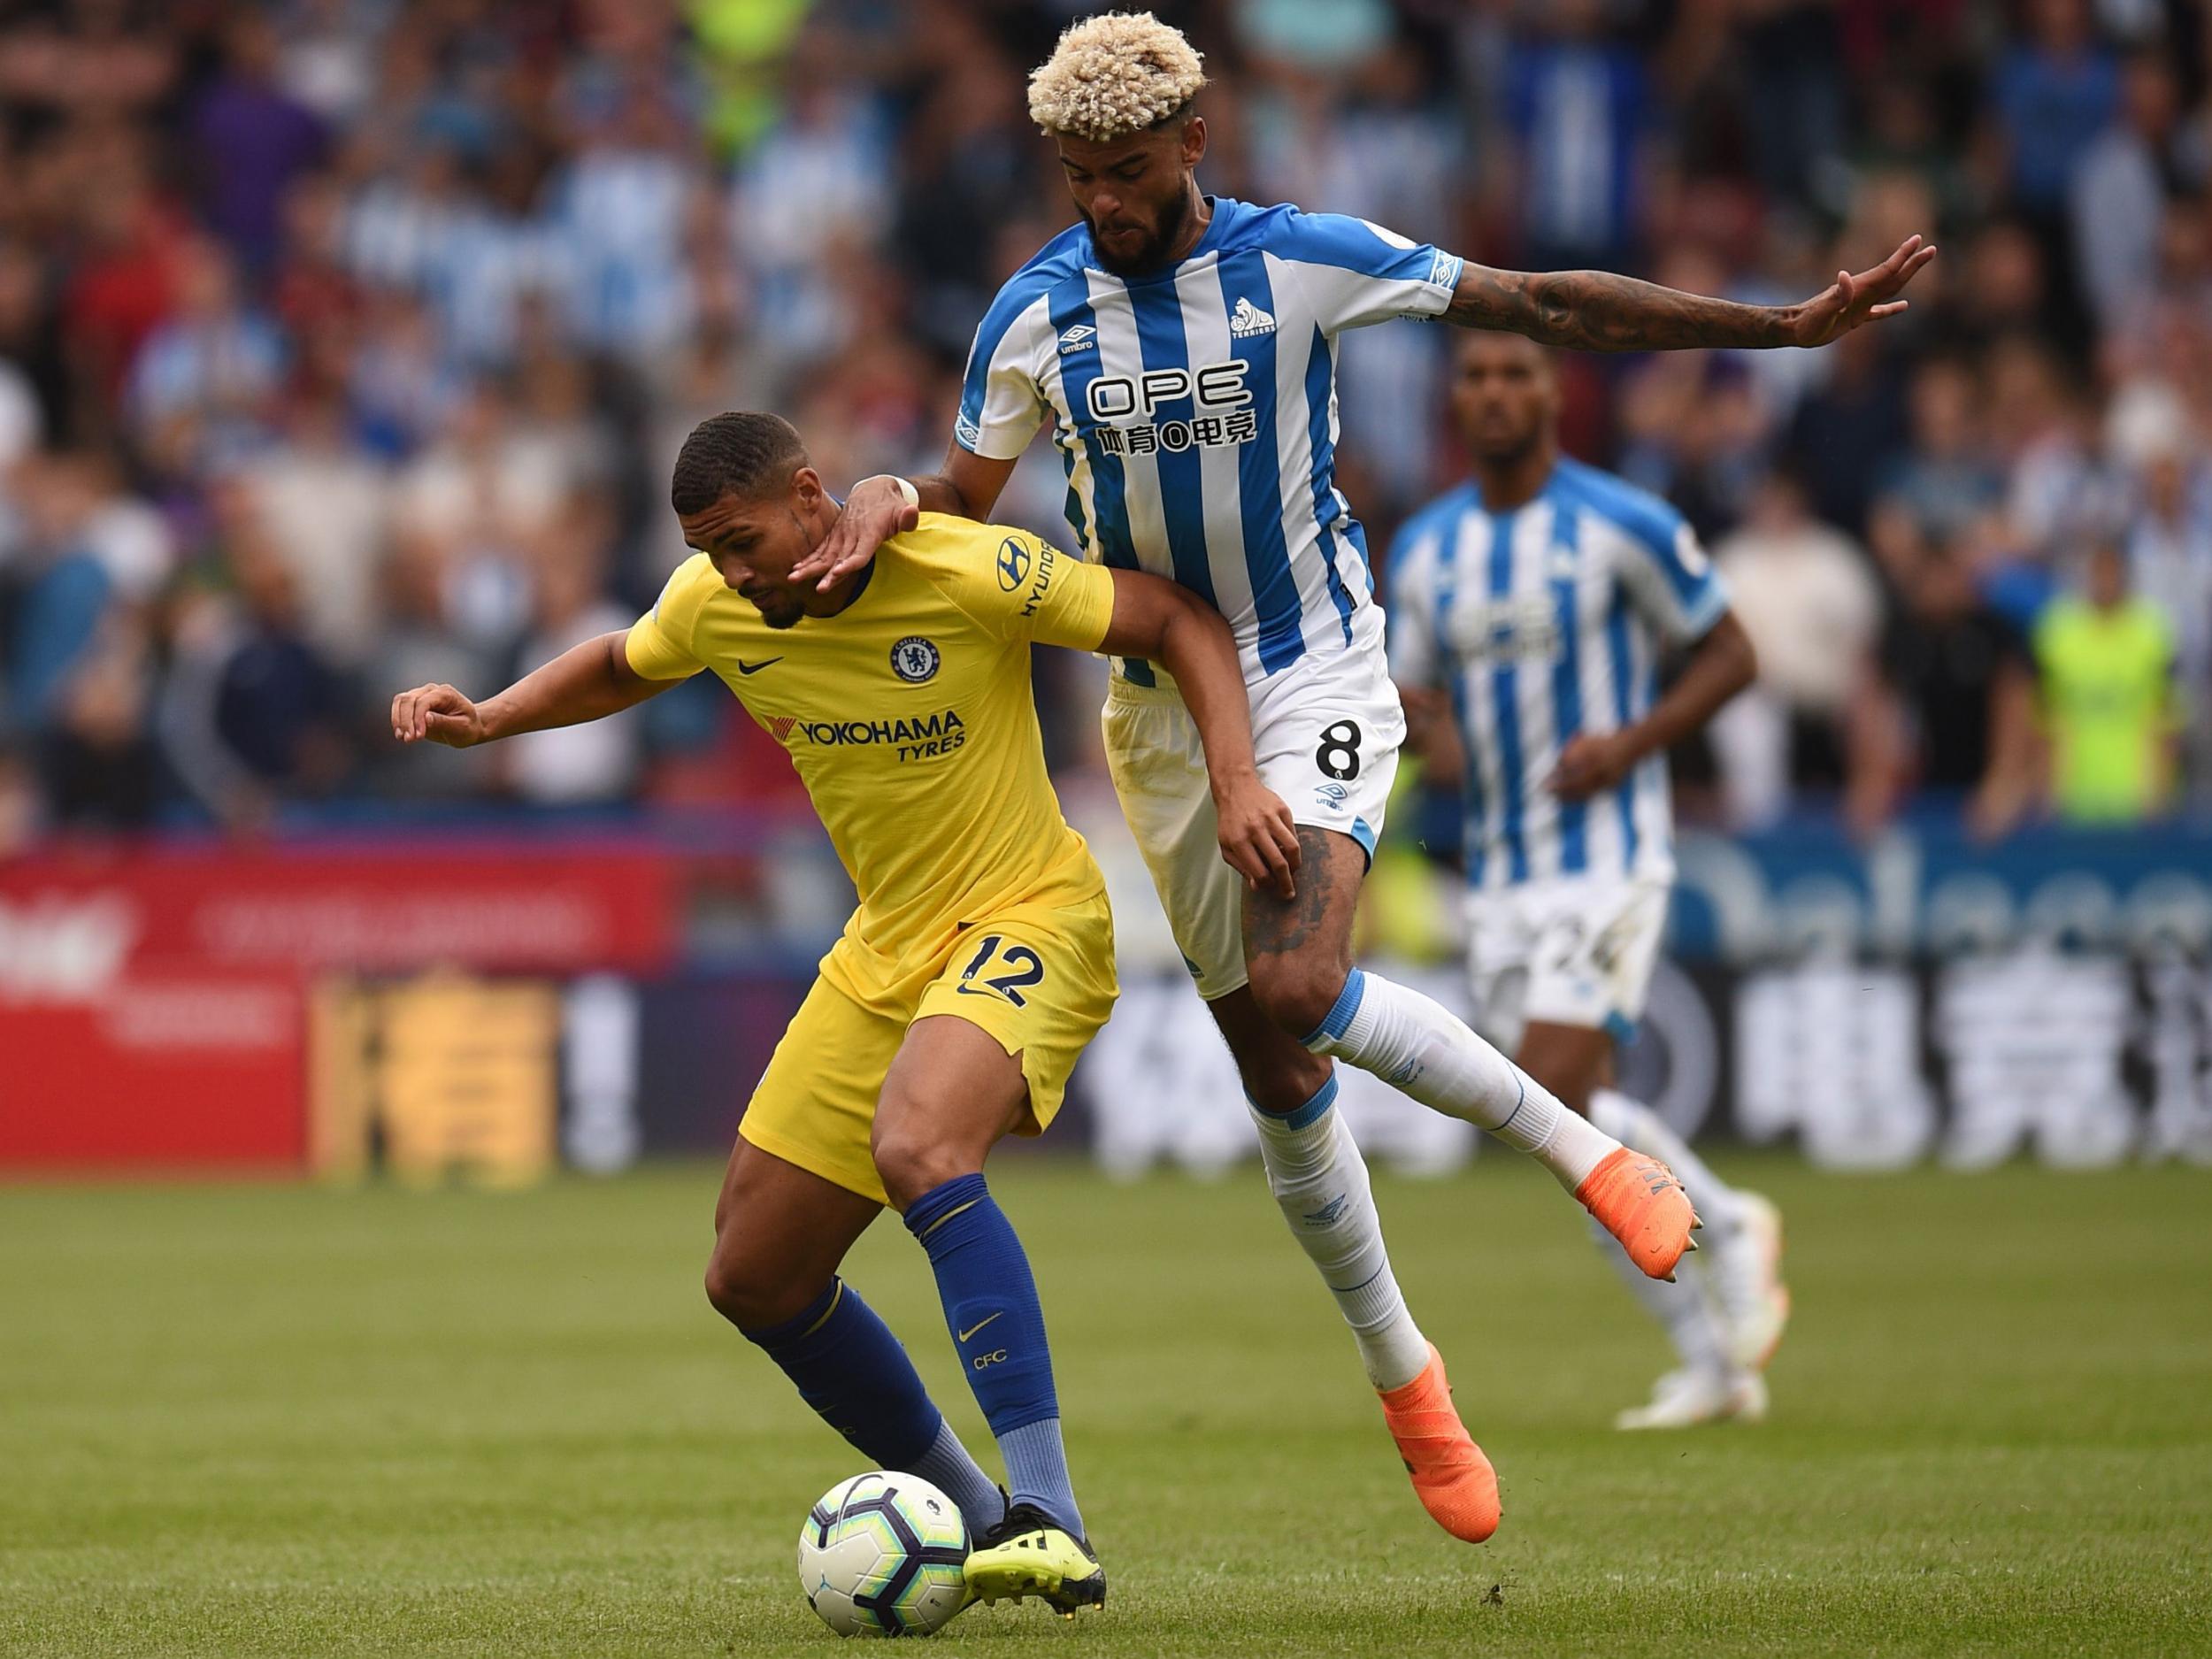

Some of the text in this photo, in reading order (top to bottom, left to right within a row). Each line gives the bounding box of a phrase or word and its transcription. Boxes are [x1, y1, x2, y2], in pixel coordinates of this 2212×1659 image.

[1232, 325, 1275, 340] TERRIERS
[1061, 341, 1094, 354] umbro
[1087, 358, 1253, 422] OPE
[895, 637, 926, 650] CHELSEA
[798, 710, 964, 746] YOKOHAMA
[896, 731, 966, 763] TYRES
[1316, 719, 1362, 781] 8
[1316, 798, 1344, 811] umbro
[961, 935, 1045, 1009] 12
[973, 1348, 1008, 1371] CFC
